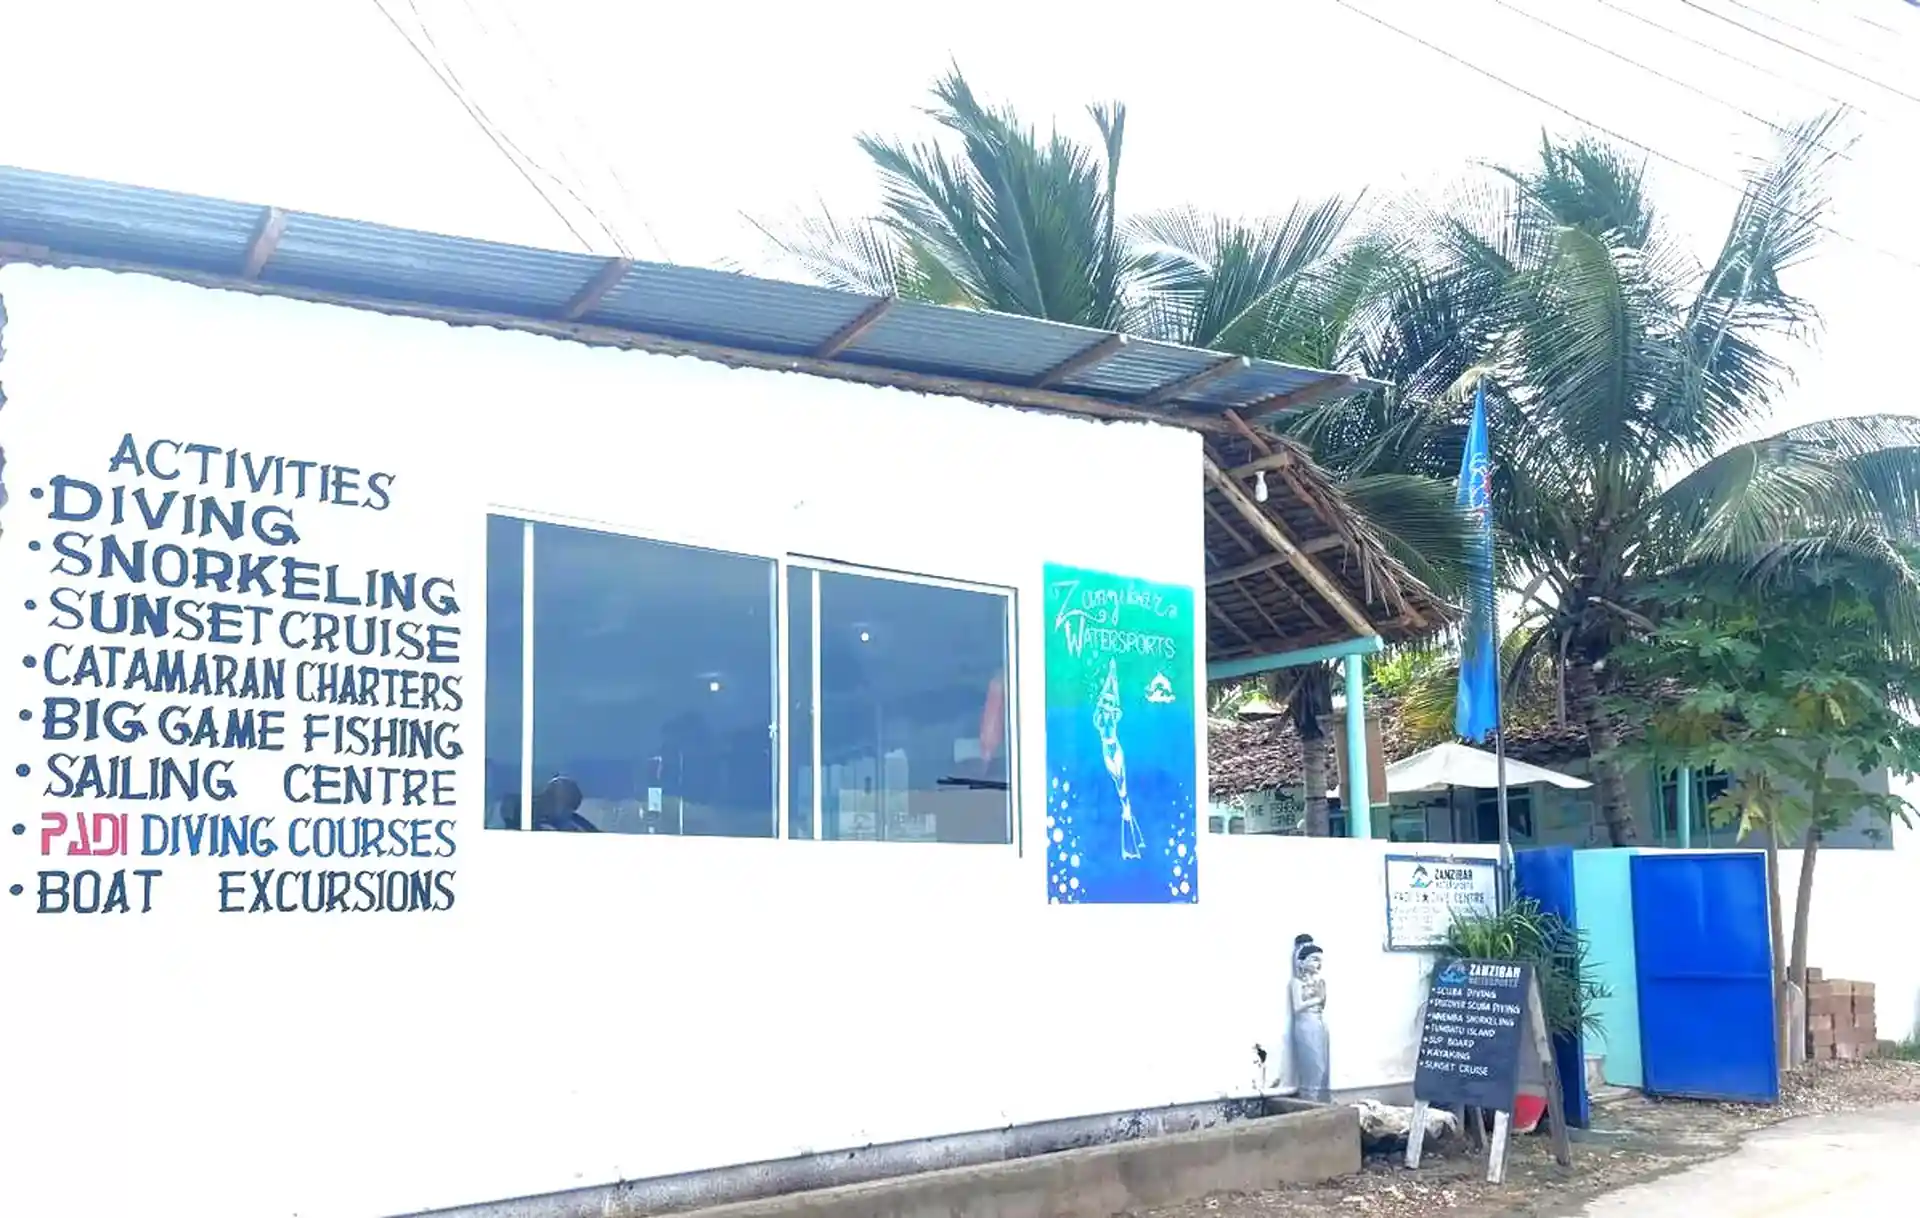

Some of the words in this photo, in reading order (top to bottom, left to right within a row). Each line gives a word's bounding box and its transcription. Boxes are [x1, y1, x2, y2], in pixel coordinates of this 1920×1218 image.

[109, 433, 396, 511] ACTIVITIES
[47, 474, 301, 546] DIVING
[50, 531, 461, 617] SNORKELING
[48, 587, 274, 646] SUNSET
[279, 609, 461, 664] CRUISE
[43, 643, 286, 701] CATAMARAN
[296, 660, 464, 712] CHARTERS
[42, 696, 148, 743] BIG
[158, 705, 286, 751] GAME
[303, 713, 464, 761] FISHING
[43, 753, 238, 802] SAILING
[283, 763, 457, 807] CENTRE
[40, 811, 128, 857] PADI
[140, 813, 279, 857] DIVING
[288, 816, 457, 859] COURSES
[36, 869, 163, 915] BOAT
[217, 868, 457, 914] EXCURSIONS
[1469, 963, 1521, 979] ZANZIBAR
